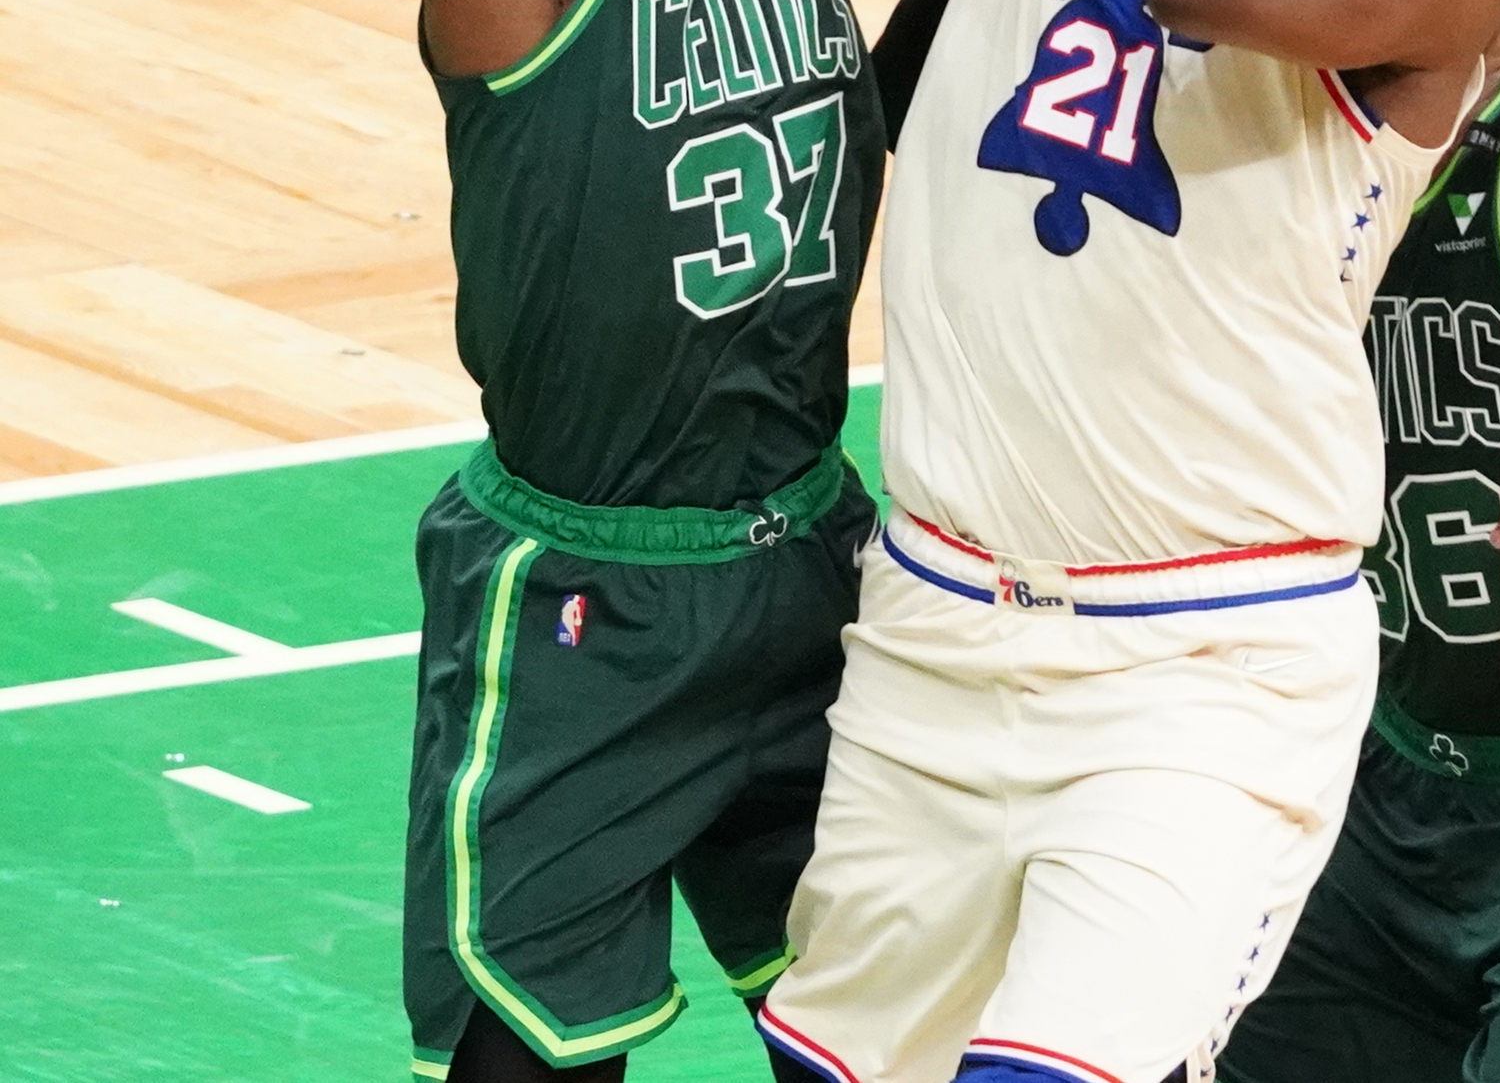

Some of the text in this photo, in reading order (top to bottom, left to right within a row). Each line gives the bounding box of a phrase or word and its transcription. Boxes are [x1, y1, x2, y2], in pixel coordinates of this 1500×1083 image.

[1019, 17, 1156, 166] 21
[666, 91, 847, 320] 37
[1434, 237, 1487, 253] vistaprint
[998, 573, 1065, 608] 76ers
